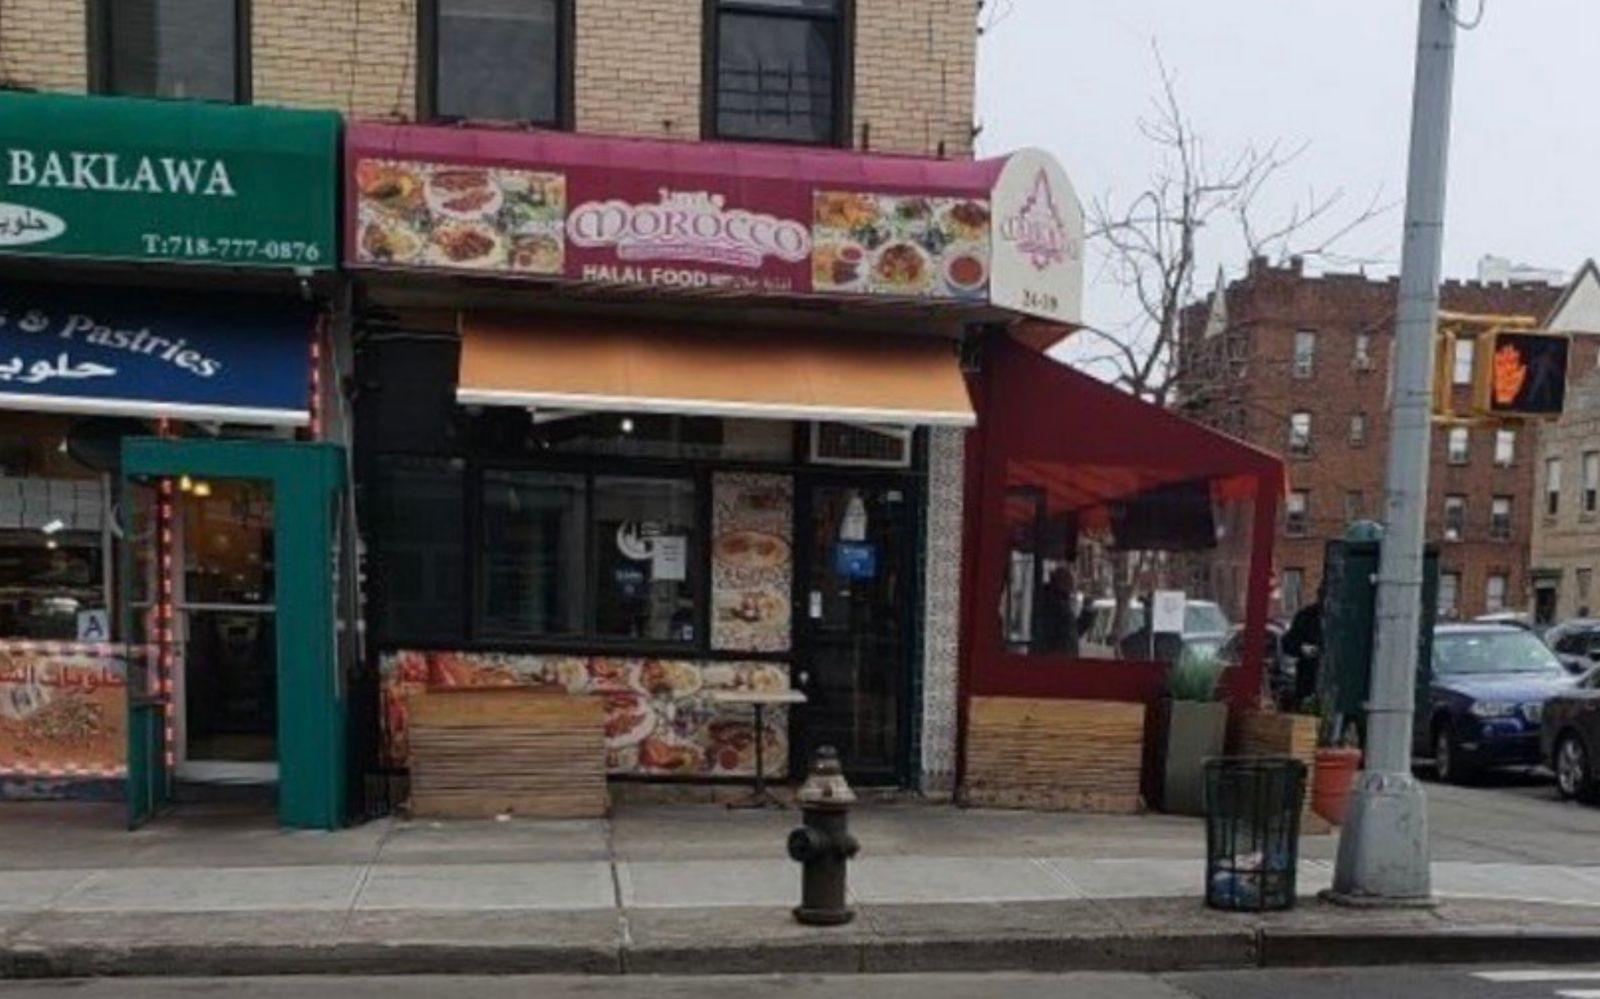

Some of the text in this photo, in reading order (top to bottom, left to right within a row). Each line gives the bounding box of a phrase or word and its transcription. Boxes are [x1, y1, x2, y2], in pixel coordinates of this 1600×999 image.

[8, 149, 237, 195] BAKLAWA
[583, 264, 644, 283] HALAL
[651, 268, 707, 288] FOOD
[17, 309, 222, 377] & Pastries
[84, 615, 104, 638] A
